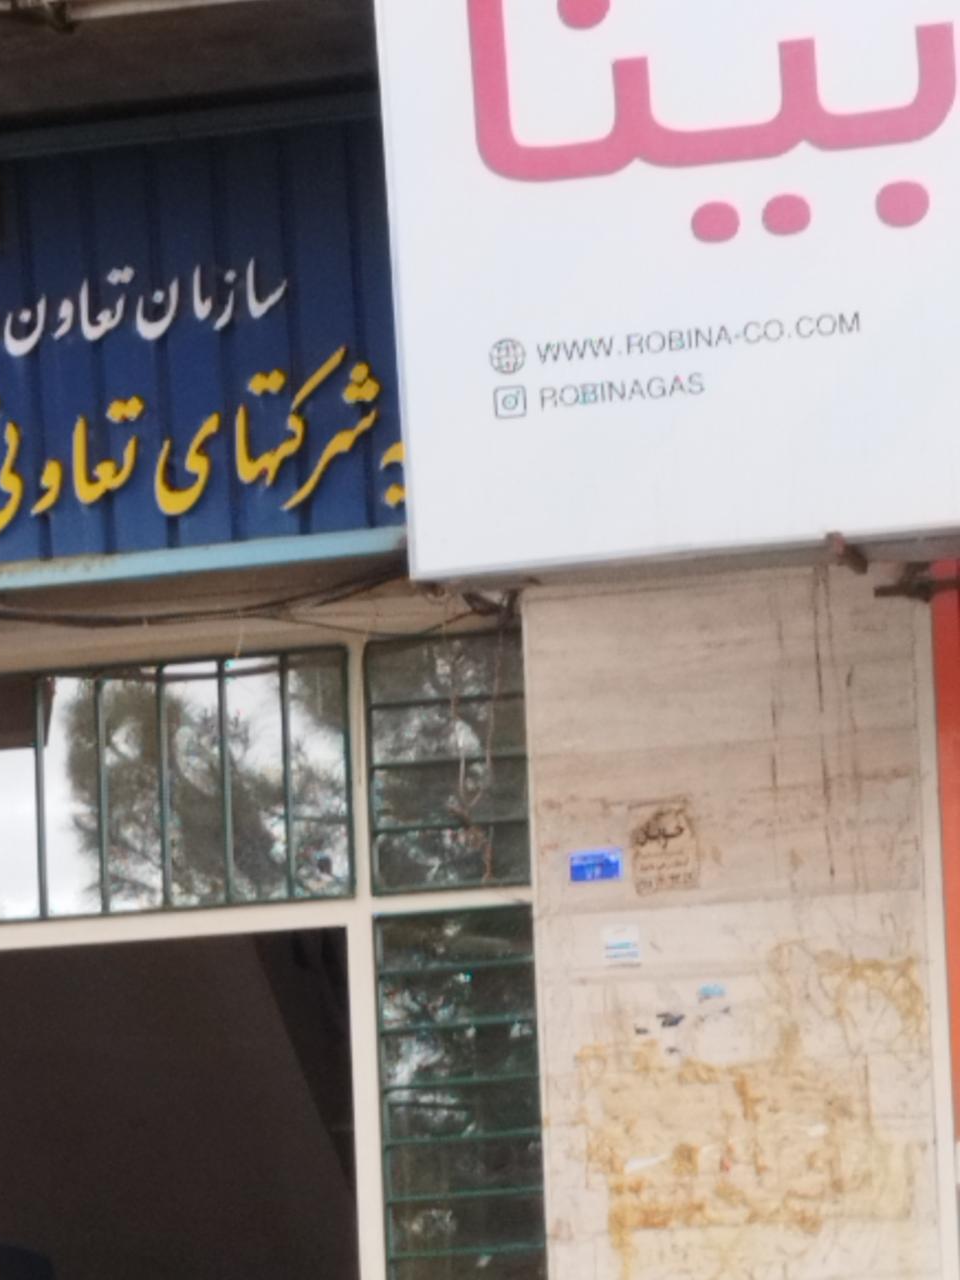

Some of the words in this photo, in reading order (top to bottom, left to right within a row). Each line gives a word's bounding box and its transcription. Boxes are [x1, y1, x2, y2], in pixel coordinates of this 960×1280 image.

[3, 263, 135, 358] تعاون
[135, 256, 289, 342] سازمان
[536, 312, 862, 363] WWW.ROBINA-CO.COM
[154, 345, 382, 517] شرکتهای
[539, 372, 706, 411] ROBINAGAS
